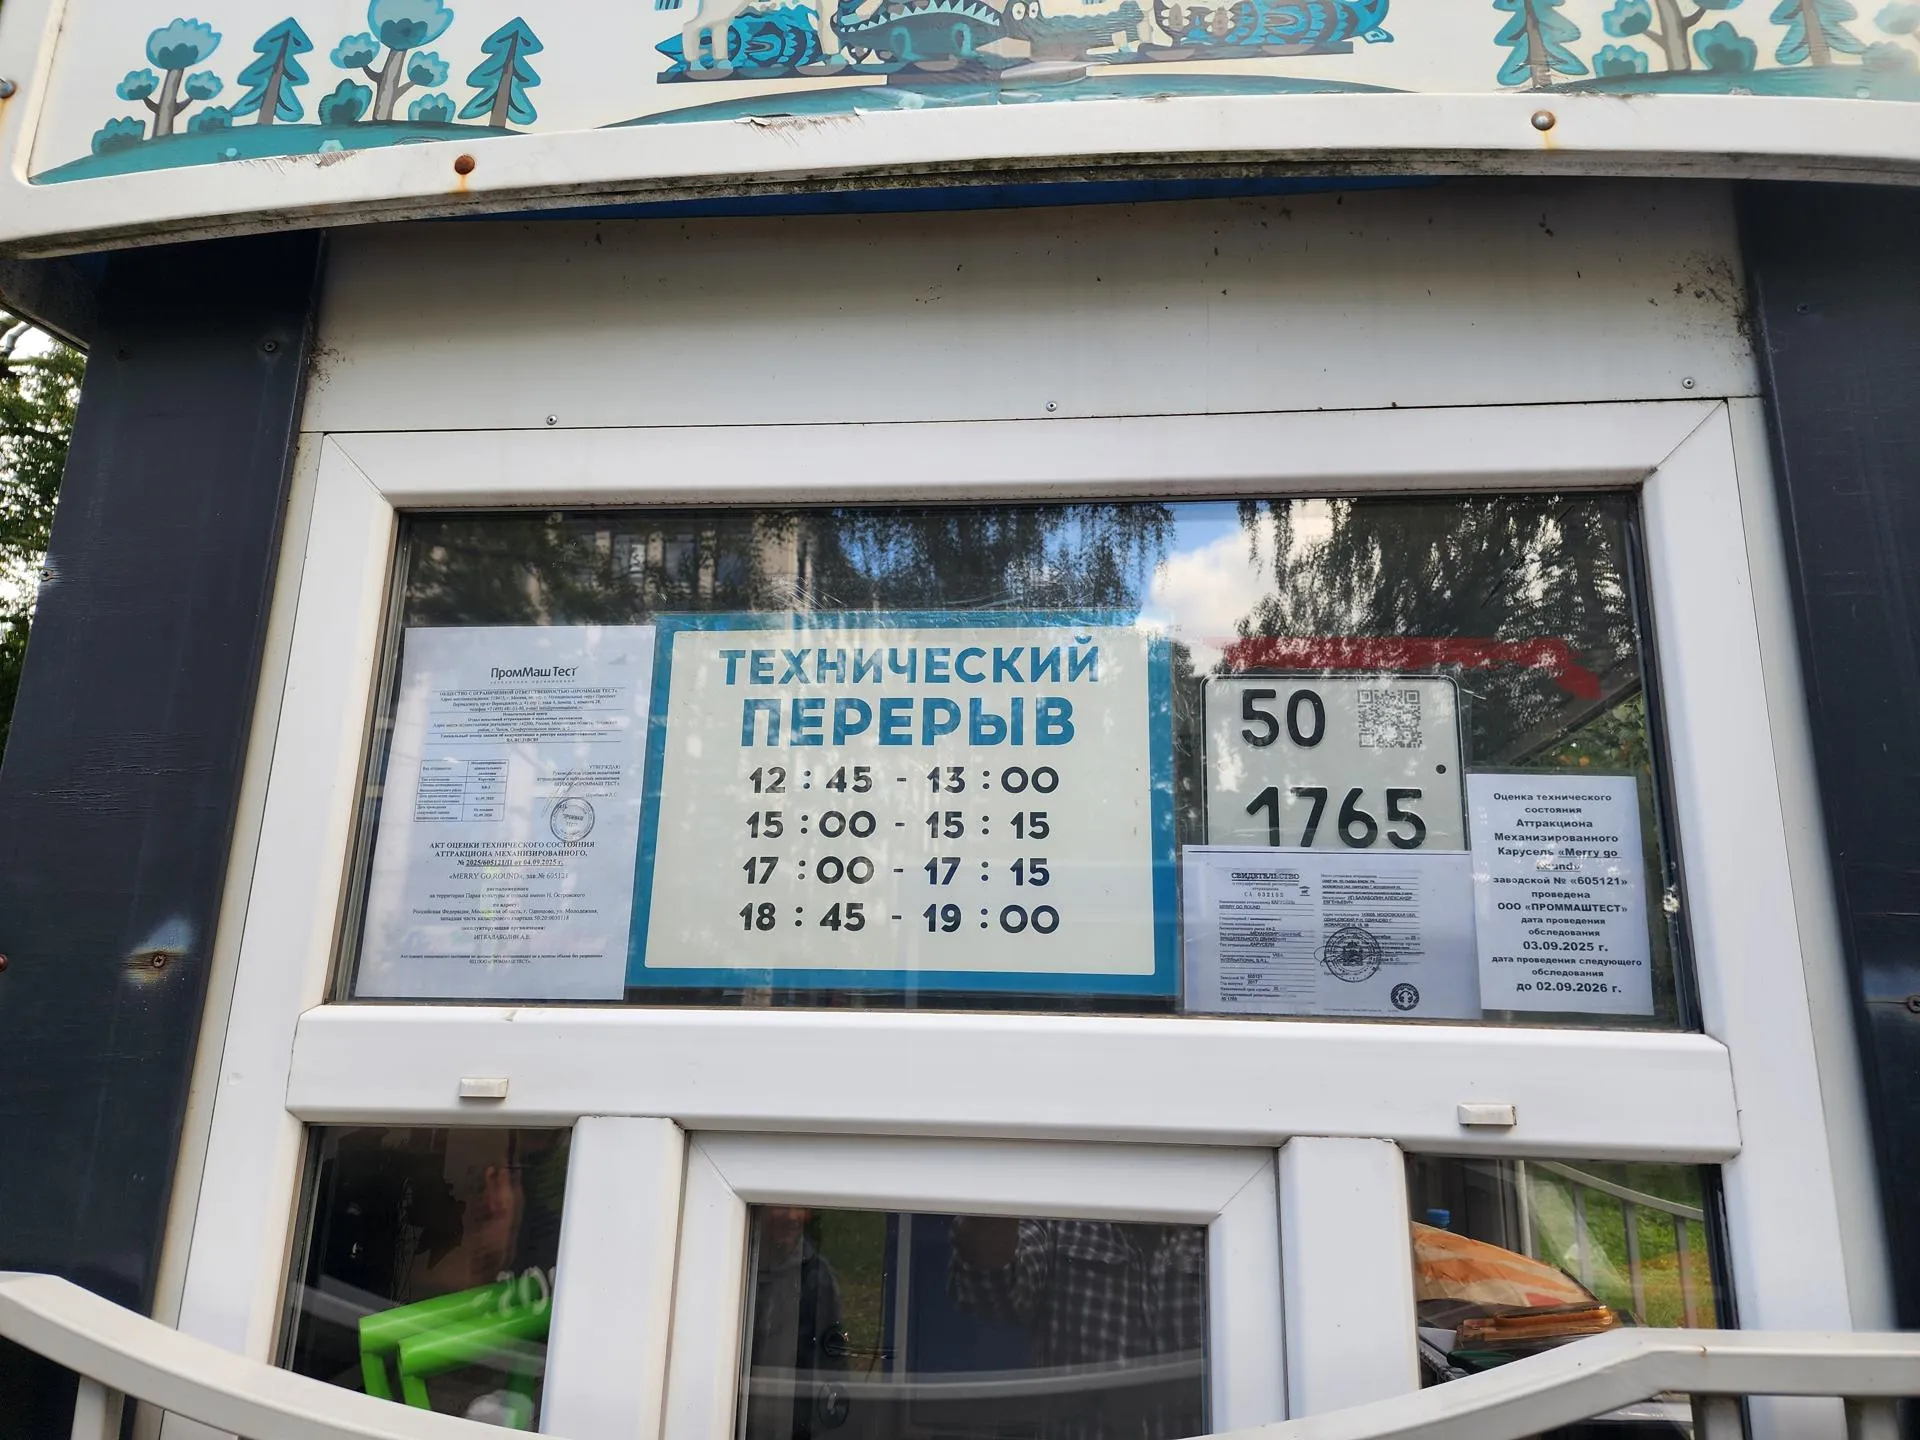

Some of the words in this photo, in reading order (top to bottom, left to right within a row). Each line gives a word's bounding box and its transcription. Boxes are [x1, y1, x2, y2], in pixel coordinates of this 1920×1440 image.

[719, 635, 1099, 685] ТЕХНИЧЕСКИЙ
[740, 697, 1075, 746] ПЕРЕРЫВ
[1242, 689, 1325, 747] 50
[1493, 792, 1533, 802] Оценка
[1536, 793, 1612, 802] технического
[1246, 786, 1426, 849] 1765
[1516, 819, 1593, 829] Аттракциона
[1494, 833, 1619, 843] Механизированного
[1498, 847, 1554, 857] Карусель
[1558, 848, 1600, 858] «Merry
[1603, 849, 1618, 858] go
[1493, 876, 1550, 884] заводской
[1570, 877, 1627, 885] «605121»
[1531, 891, 1591, 900] проведена
[1498, 902, 1522, 911] ООО
[1525, 902, 1628, 912] «ПРОММАШТЕСТ»
[1521, 917, 1543, 925] дата
[1546, 917, 1606, 926] проведения
[1528, 928, 1600, 937] обследования
[1523, 941, 1594, 951] 03.09.2025
[1598, 944, 1608, 952] г.
[1491, 955, 1514, 964] дата
[1516, 956, 1576, 965] проведения
[1579, 958, 1642, 967] следующего
[1532, 968, 1604, 977] обследования
[1516, 982, 1532, 992] до
[1536, 981, 1608, 993] 02.09.2026
[1612, 985, 1622, 993] г.
